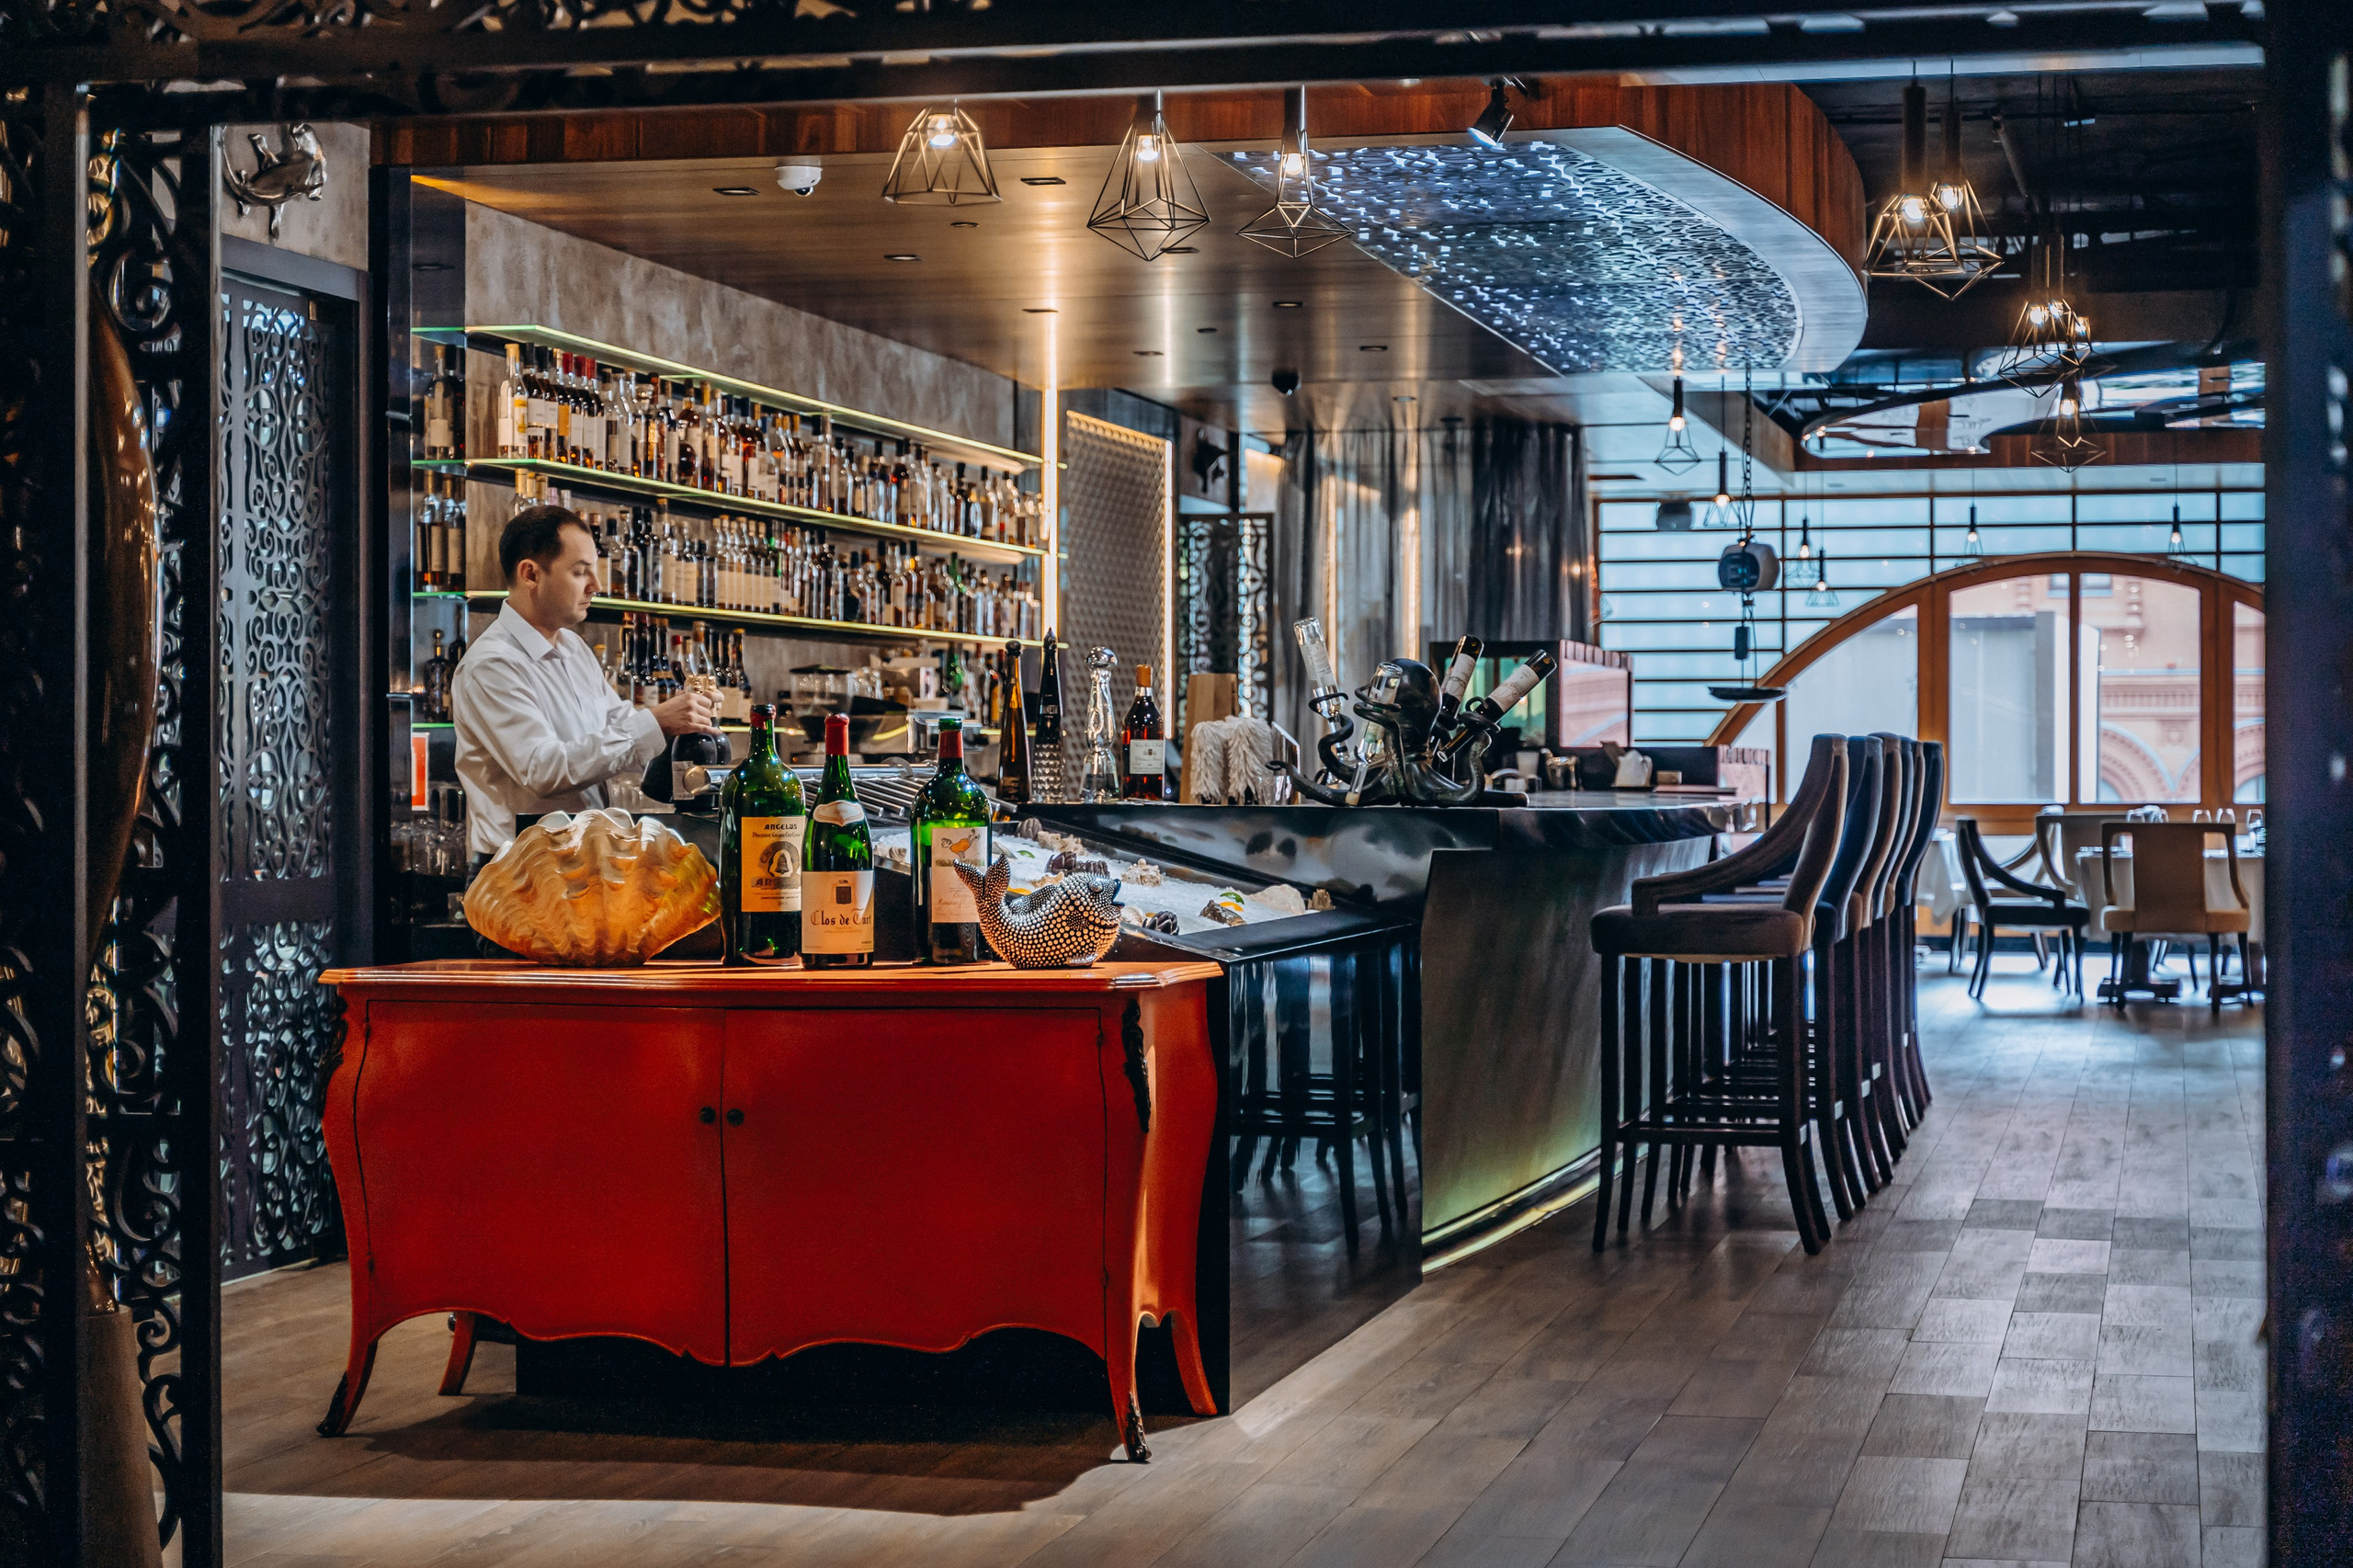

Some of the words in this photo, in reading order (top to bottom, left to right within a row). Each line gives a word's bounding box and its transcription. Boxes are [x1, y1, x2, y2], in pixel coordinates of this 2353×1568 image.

[810, 909, 836, 926] Clos
[839, 914, 850, 926] de
[851, 908, 871, 925] Tart
